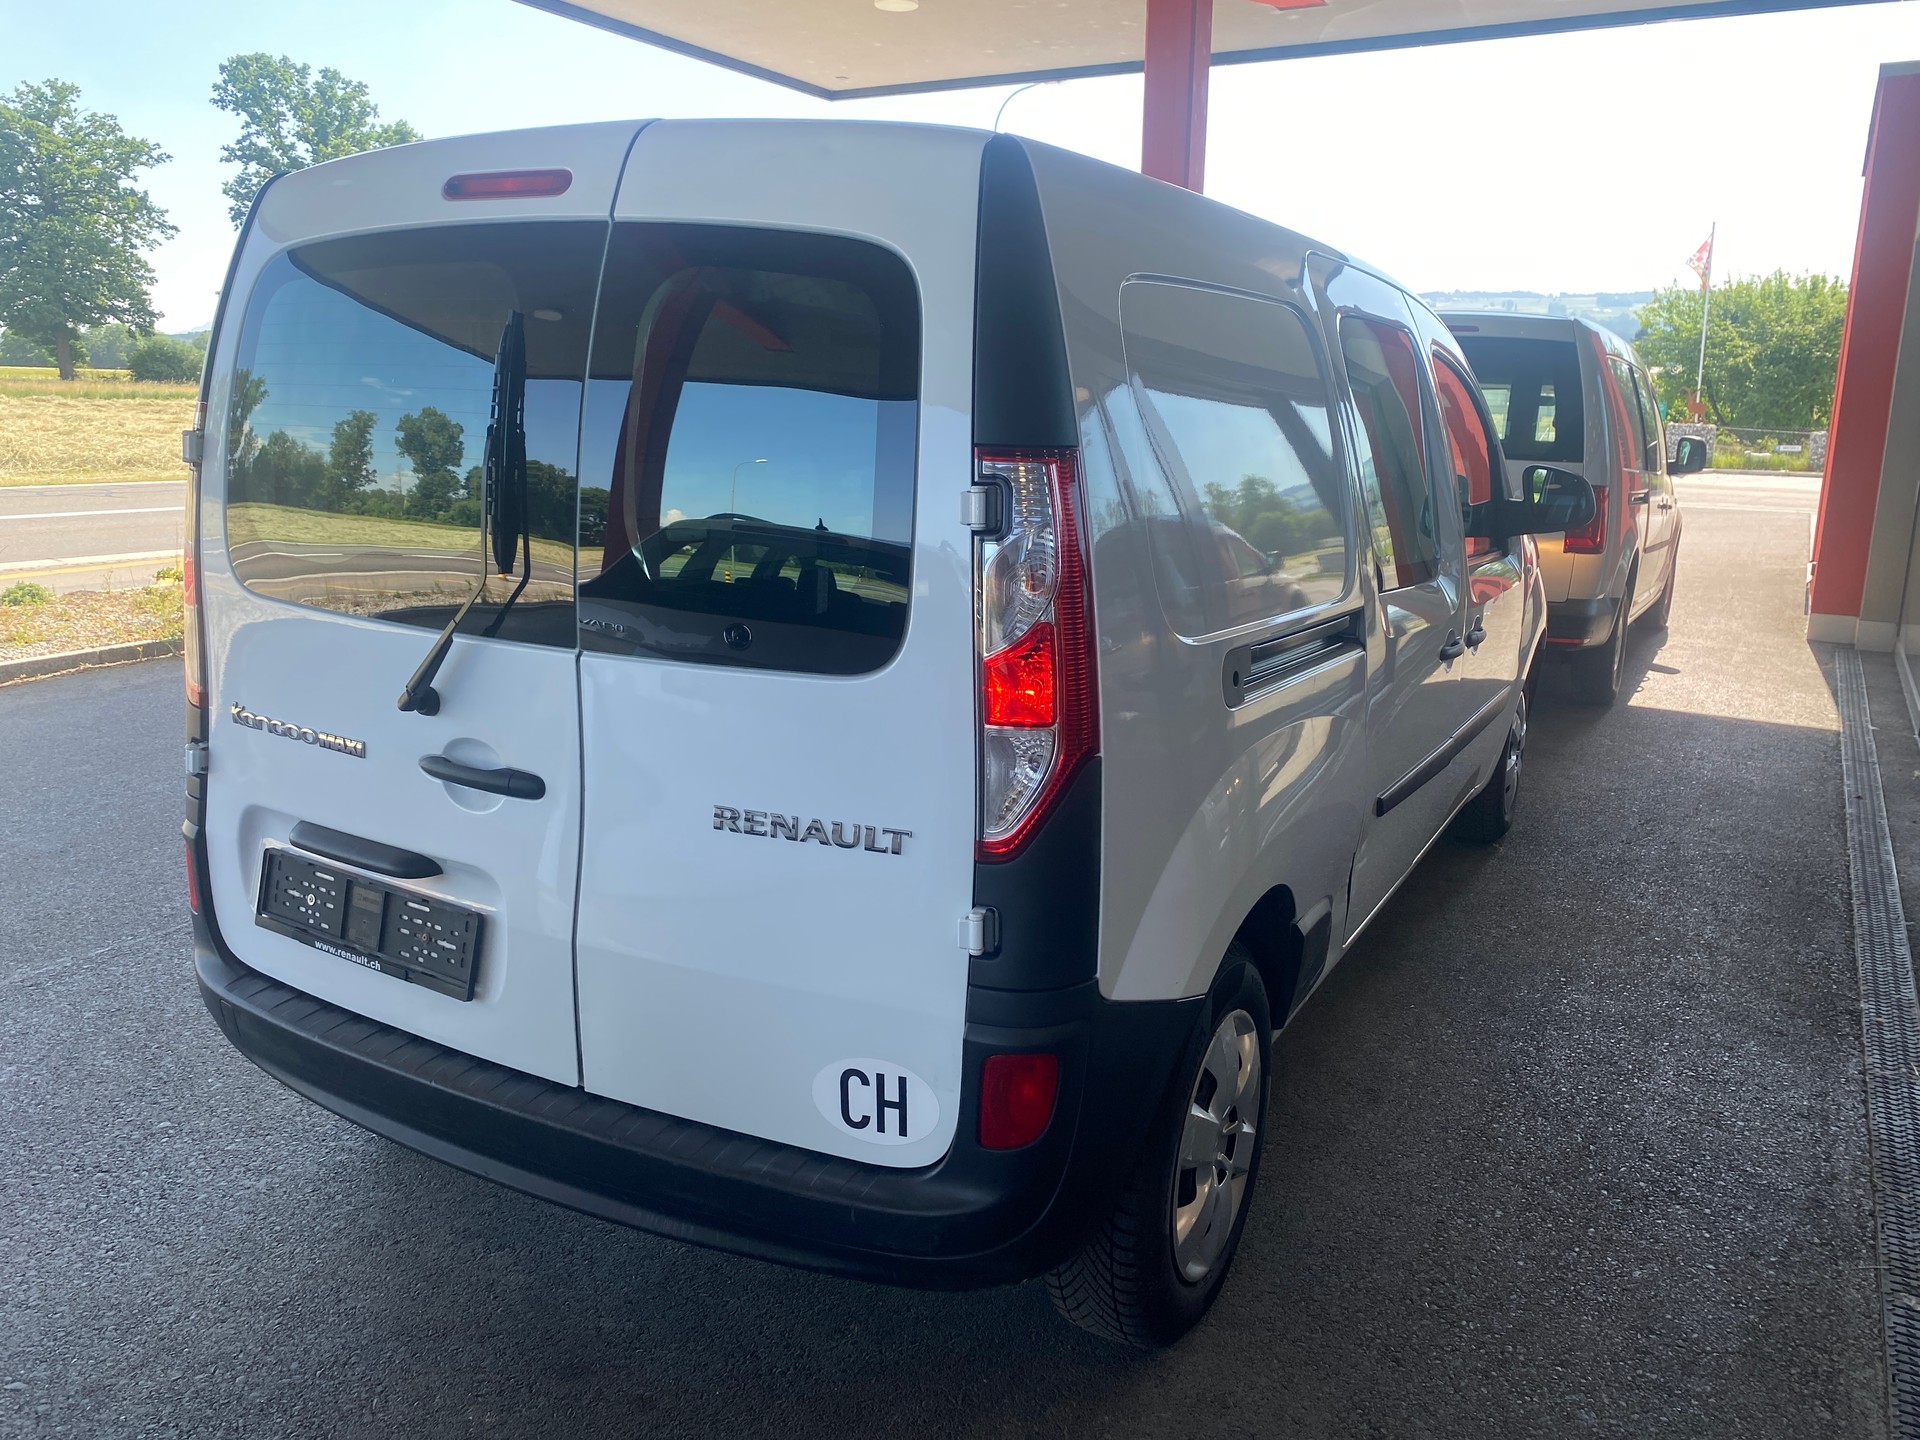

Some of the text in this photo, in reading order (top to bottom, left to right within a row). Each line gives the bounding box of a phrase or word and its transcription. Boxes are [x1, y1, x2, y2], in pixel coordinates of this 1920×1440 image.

[318, 731, 366, 759] MAXI
[713, 805, 912, 855] RENAULT
[314, 940, 381, 970] www.renault.ch
[840, 1068, 907, 1137] CH
